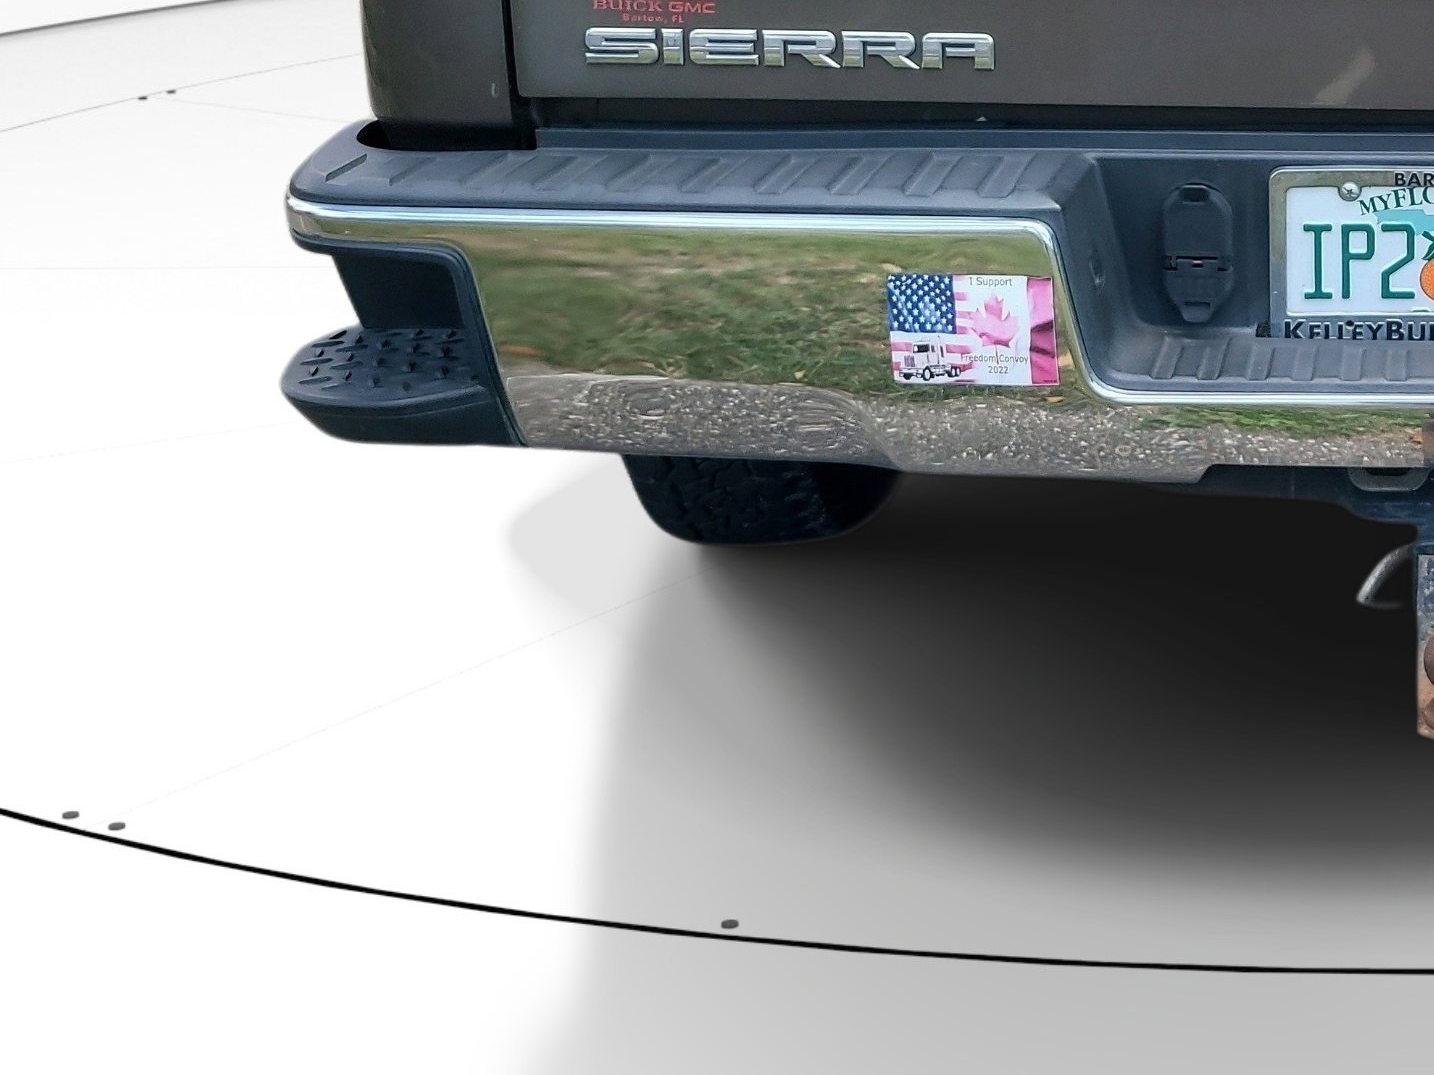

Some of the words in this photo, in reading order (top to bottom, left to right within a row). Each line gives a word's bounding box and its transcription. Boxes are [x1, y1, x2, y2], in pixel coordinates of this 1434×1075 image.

[668, 2, 716, 14] GMC
[672, 14, 684, 23] FL
[585, 27, 996, 70] SIERRA
[1303, 223, 1416, 300] IP2
[976, 277, 1012, 287] Support
[961, 354, 996, 363] Freedom
[999, 354, 1028, 365] Convoy
[988, 365, 1009, 374] 2022
